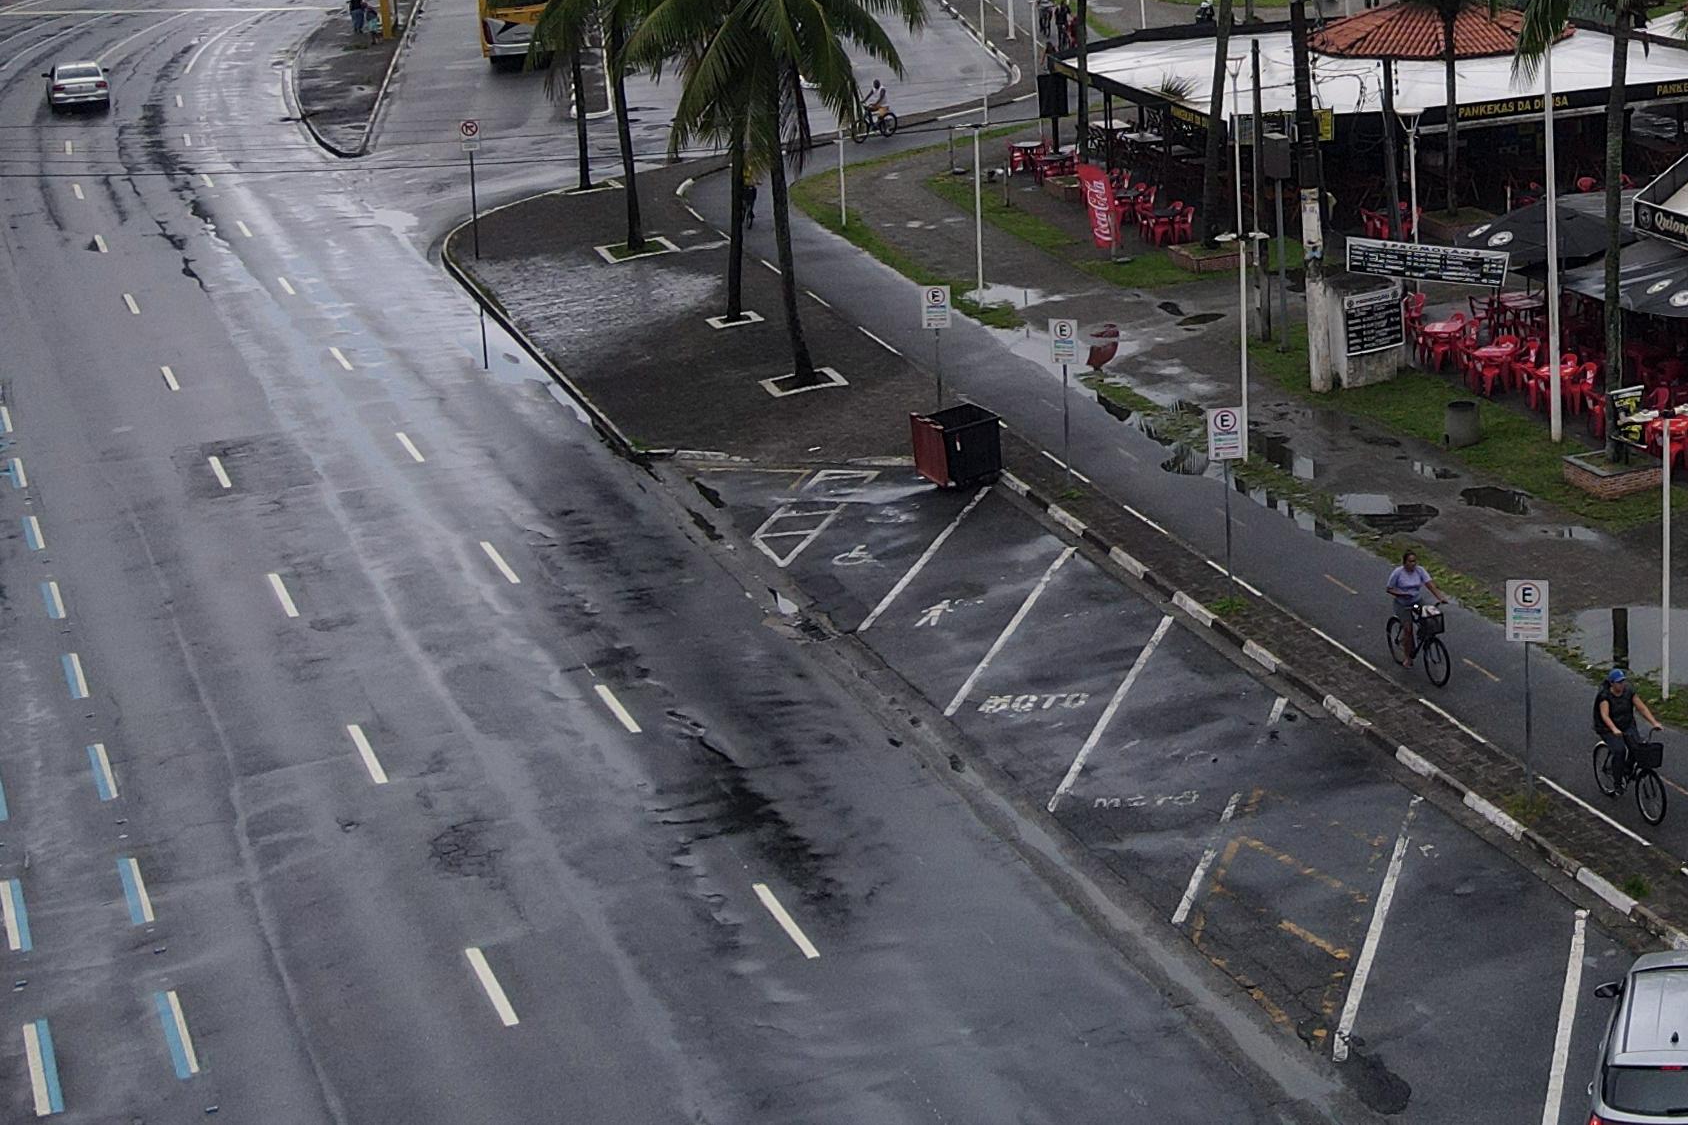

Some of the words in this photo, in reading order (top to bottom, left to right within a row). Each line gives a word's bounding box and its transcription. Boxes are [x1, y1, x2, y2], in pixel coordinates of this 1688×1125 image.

[1458, 101, 1515, 118] PANKEKAS
[1517, 100, 1531, 111] DA
[1533, 95, 1569, 109] DIISA
[1059, 324, 1067, 336] E
[1220, 414, 1230, 427] E
[1522, 587, 1533, 603] E
